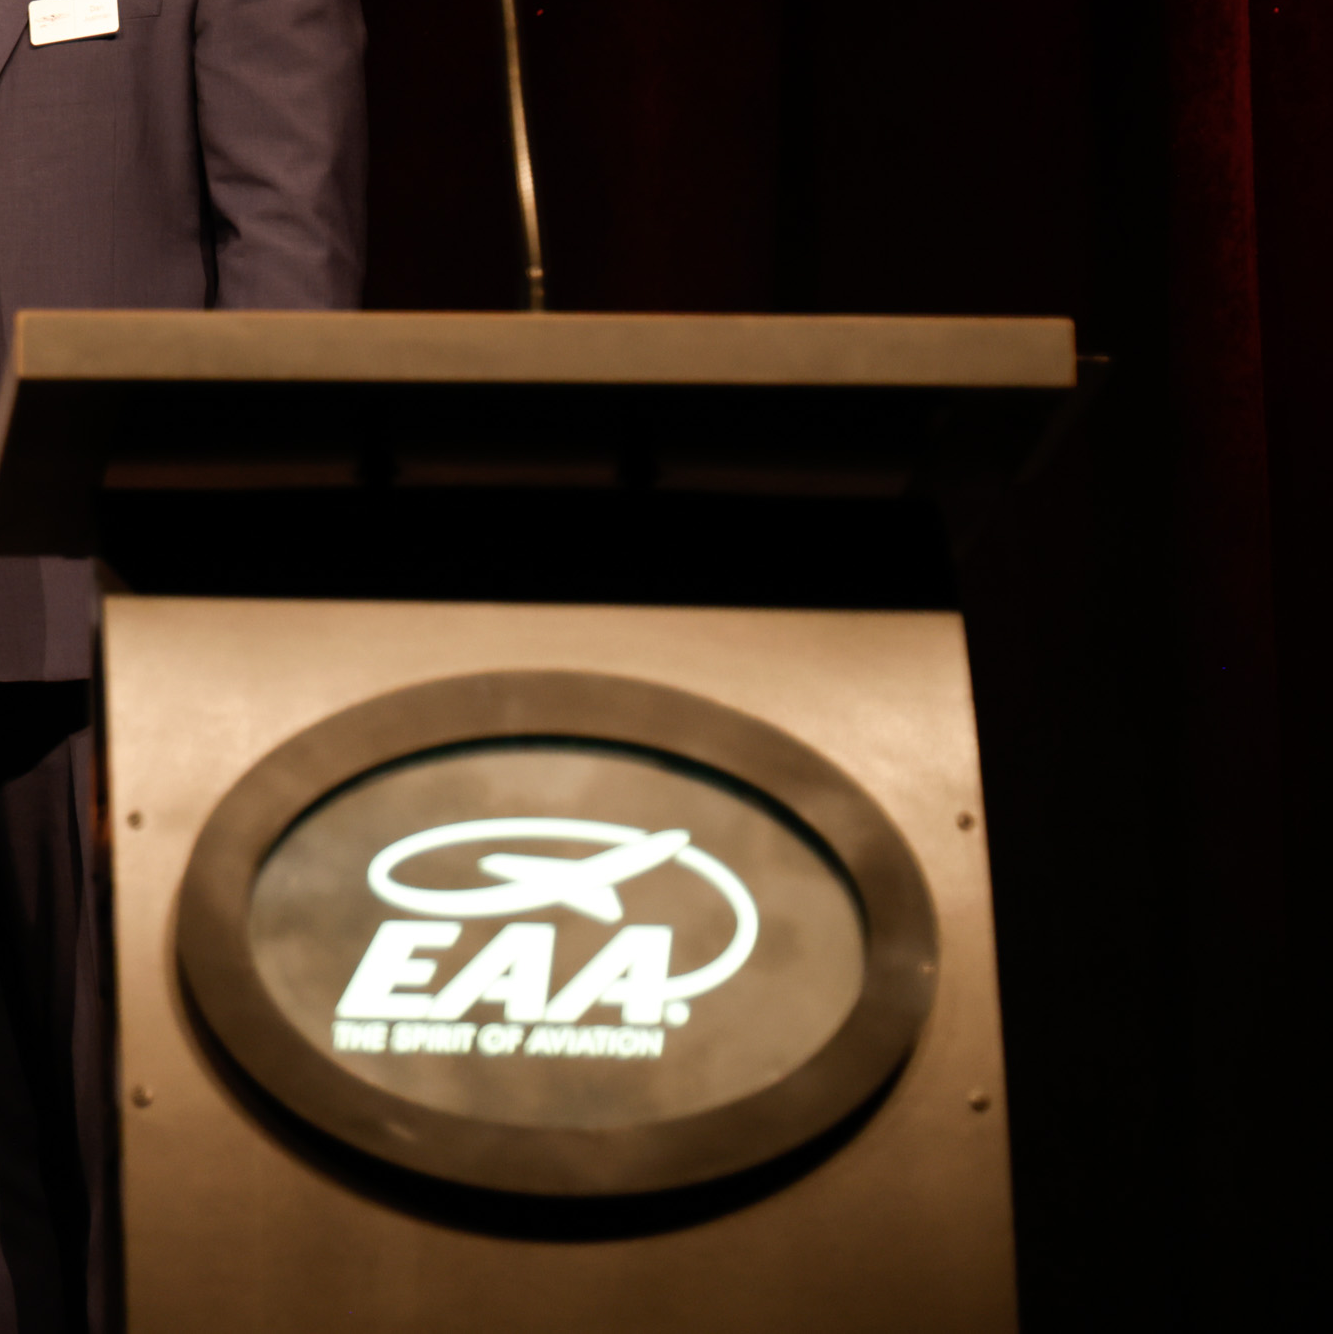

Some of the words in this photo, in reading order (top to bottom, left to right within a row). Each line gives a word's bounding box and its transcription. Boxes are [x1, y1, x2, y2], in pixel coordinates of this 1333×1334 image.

[334, 919, 673, 1025] EAA
[334, 1021, 387, 1054] THE
[389, 1022, 477, 1055] SPIRIT
[477, 1023, 525, 1056] OF
[525, 1025, 665, 1058] AVIATION
